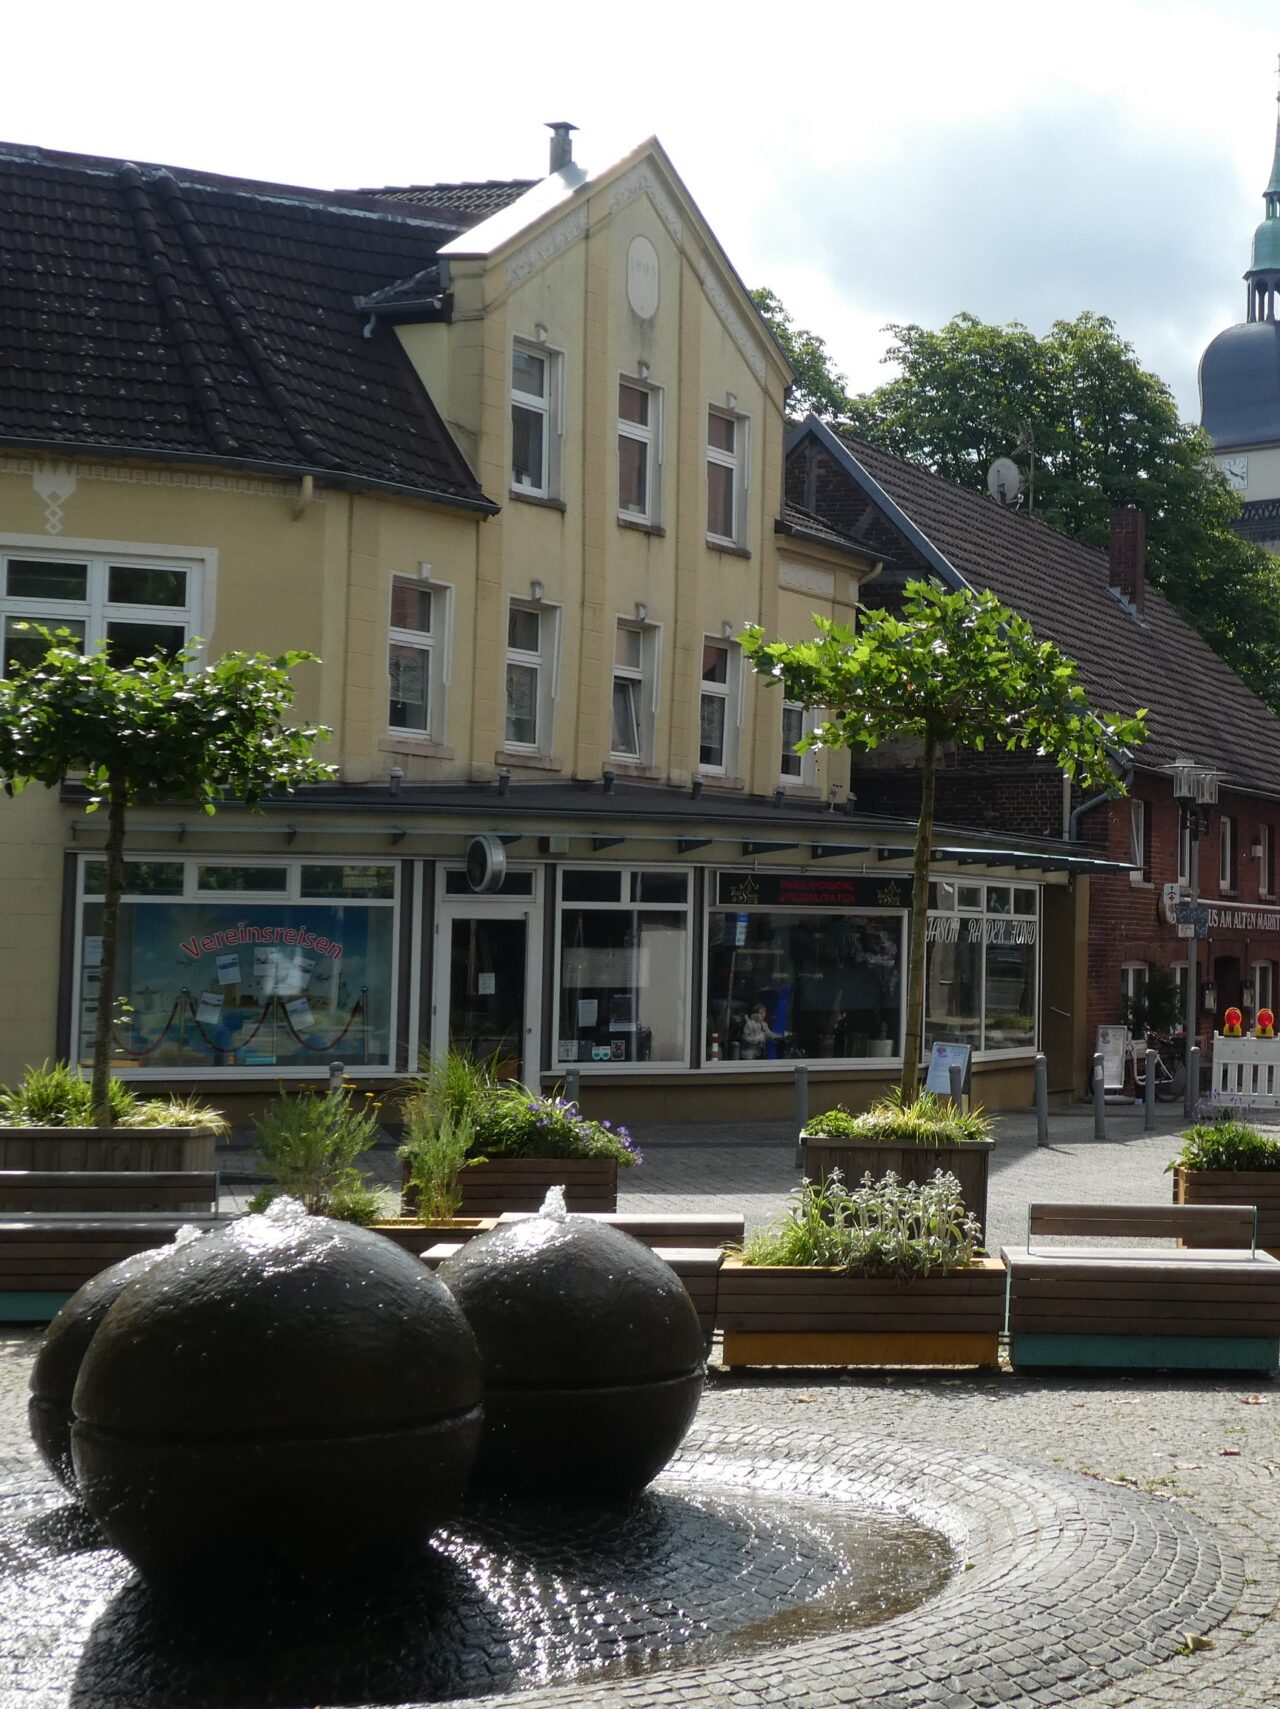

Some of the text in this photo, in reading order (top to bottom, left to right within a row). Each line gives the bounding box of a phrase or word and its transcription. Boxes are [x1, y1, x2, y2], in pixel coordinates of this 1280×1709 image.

[1220, 910, 1232, 928] AM
[1233, 911, 1257, 930] ALTEN
[1257, 912, 1280, 931] MARKT
[179, 922, 343, 960] Vereinsreisen
